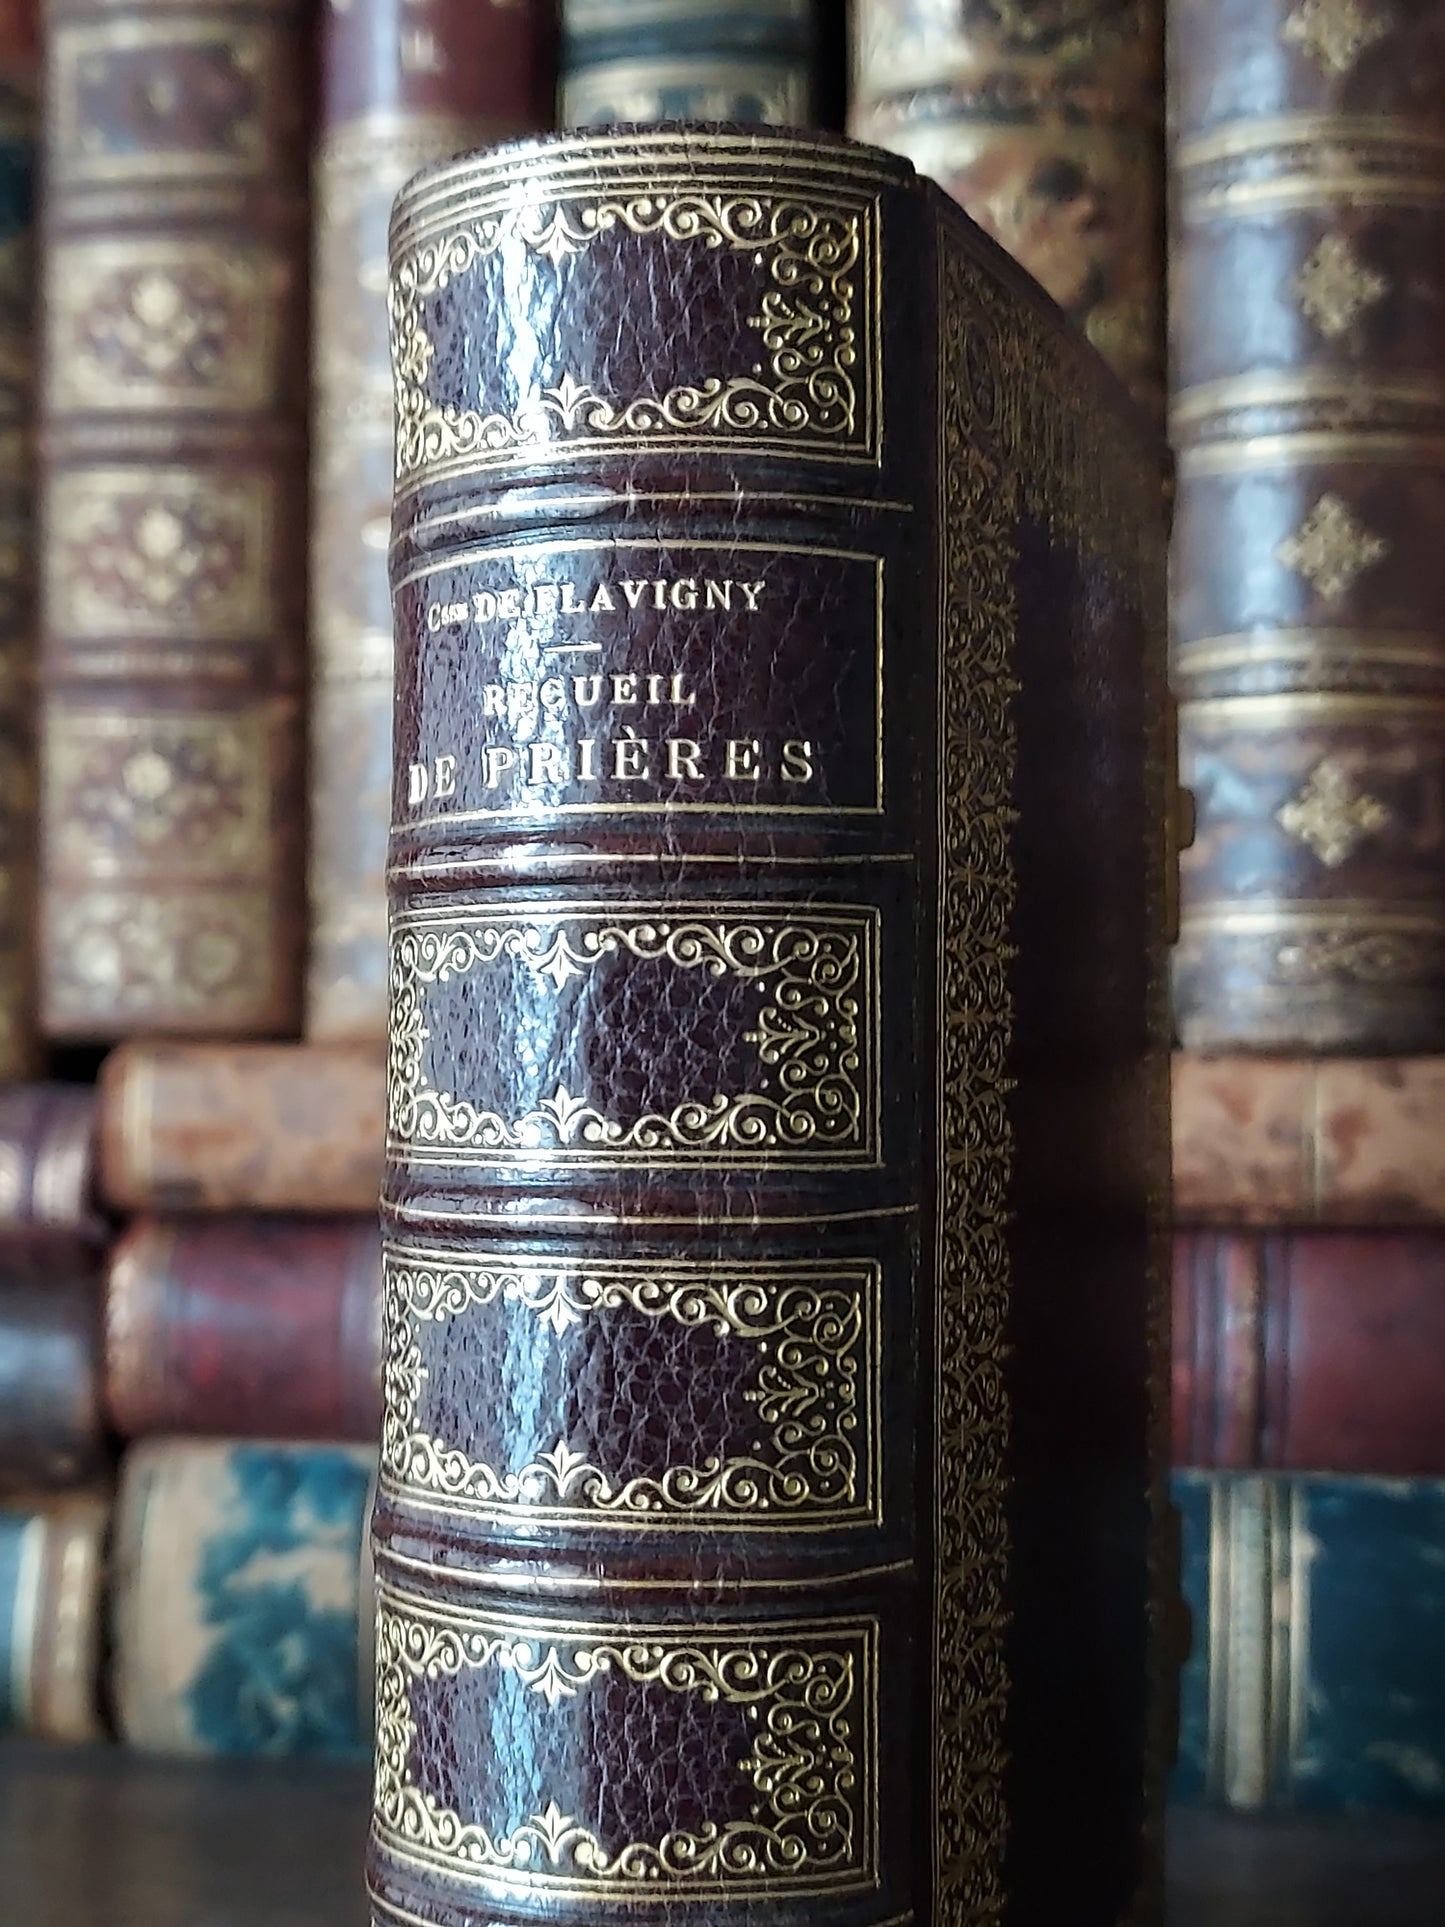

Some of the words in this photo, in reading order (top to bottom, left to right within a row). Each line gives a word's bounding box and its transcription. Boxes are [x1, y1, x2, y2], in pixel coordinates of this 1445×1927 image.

[473, 588, 521, 623] DE
[535, 580, 767, 614] FLAVIGNY
[484, 674, 696, 717] RECUEIL
[408, 756, 456, 804] DE
[486, 726, 814, 790] PRIÈRES
